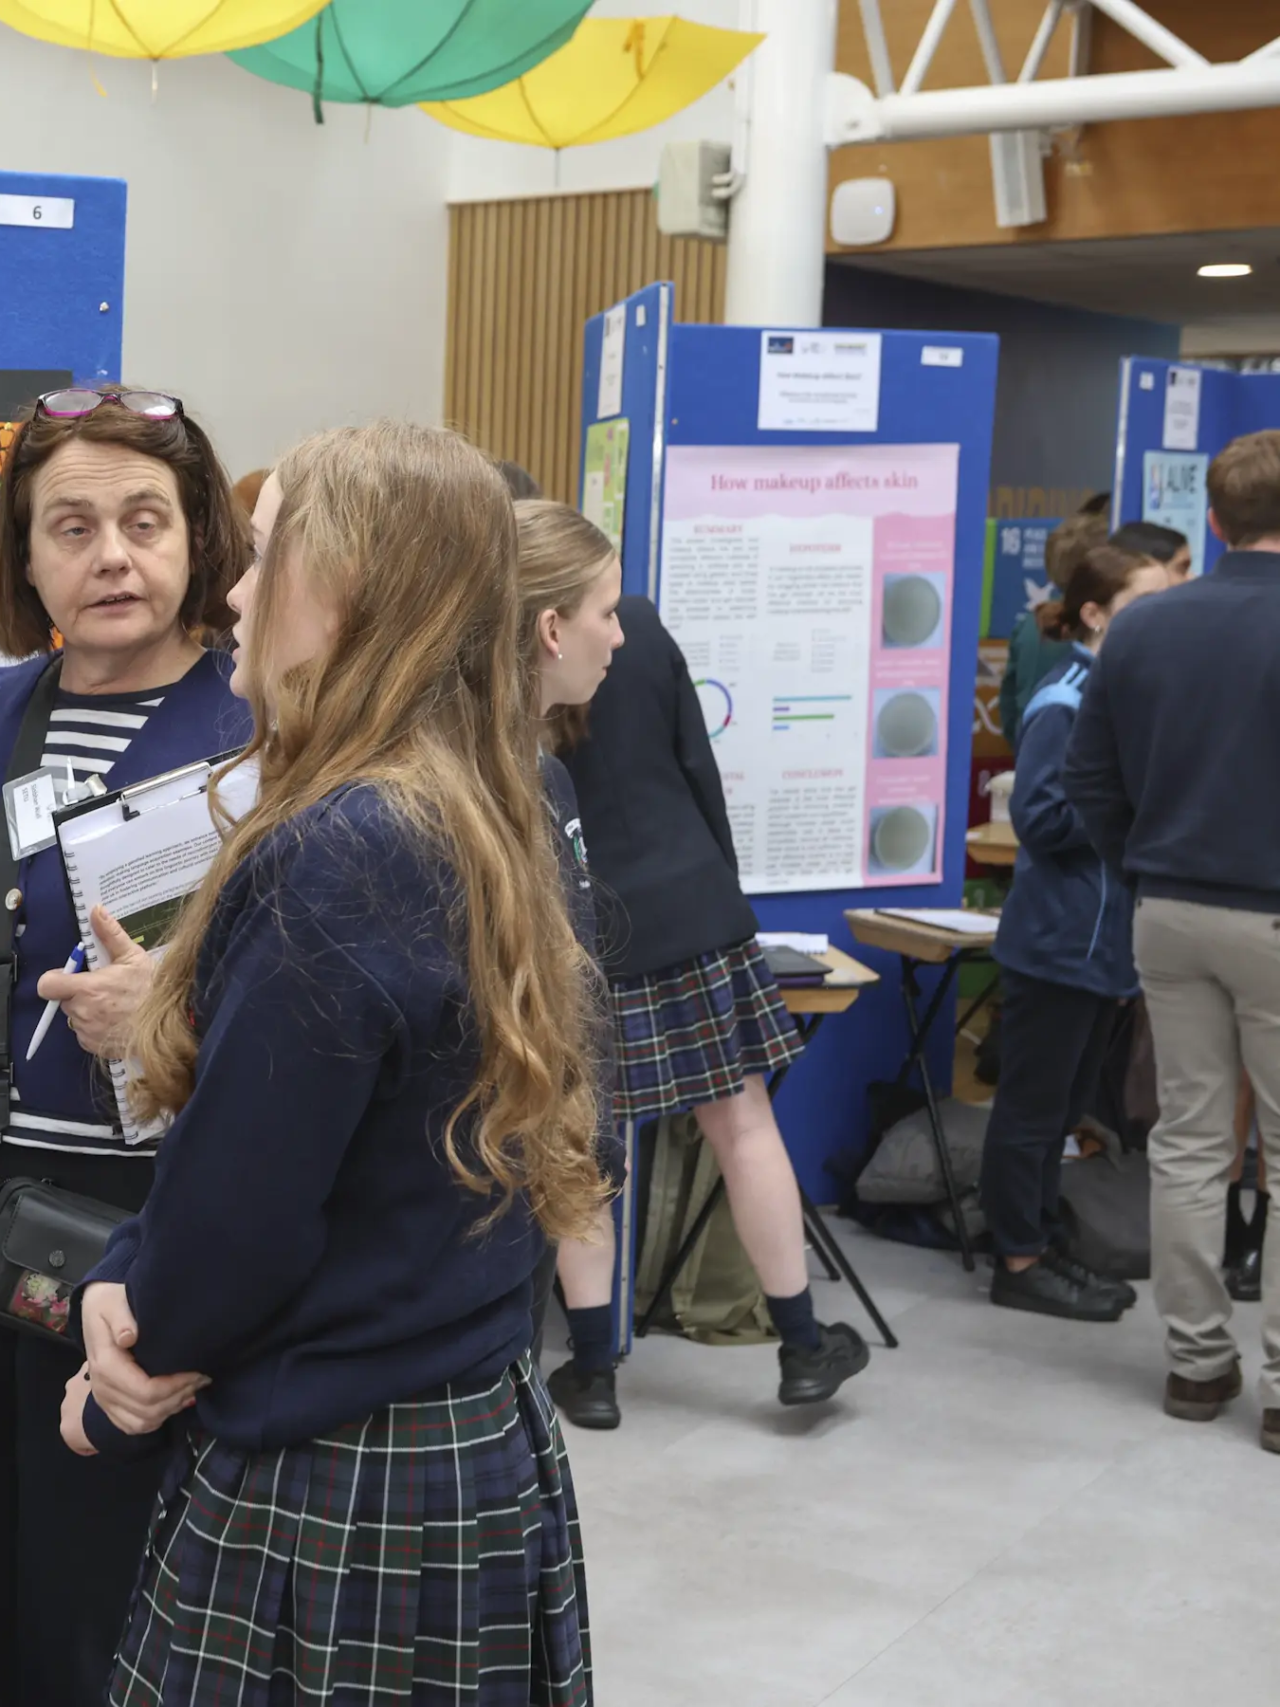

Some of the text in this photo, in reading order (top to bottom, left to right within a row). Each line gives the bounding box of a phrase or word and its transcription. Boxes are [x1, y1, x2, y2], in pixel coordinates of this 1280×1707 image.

[32, 206, 42, 220] 6
[711, 471, 919, 494] How makeup affects skin
